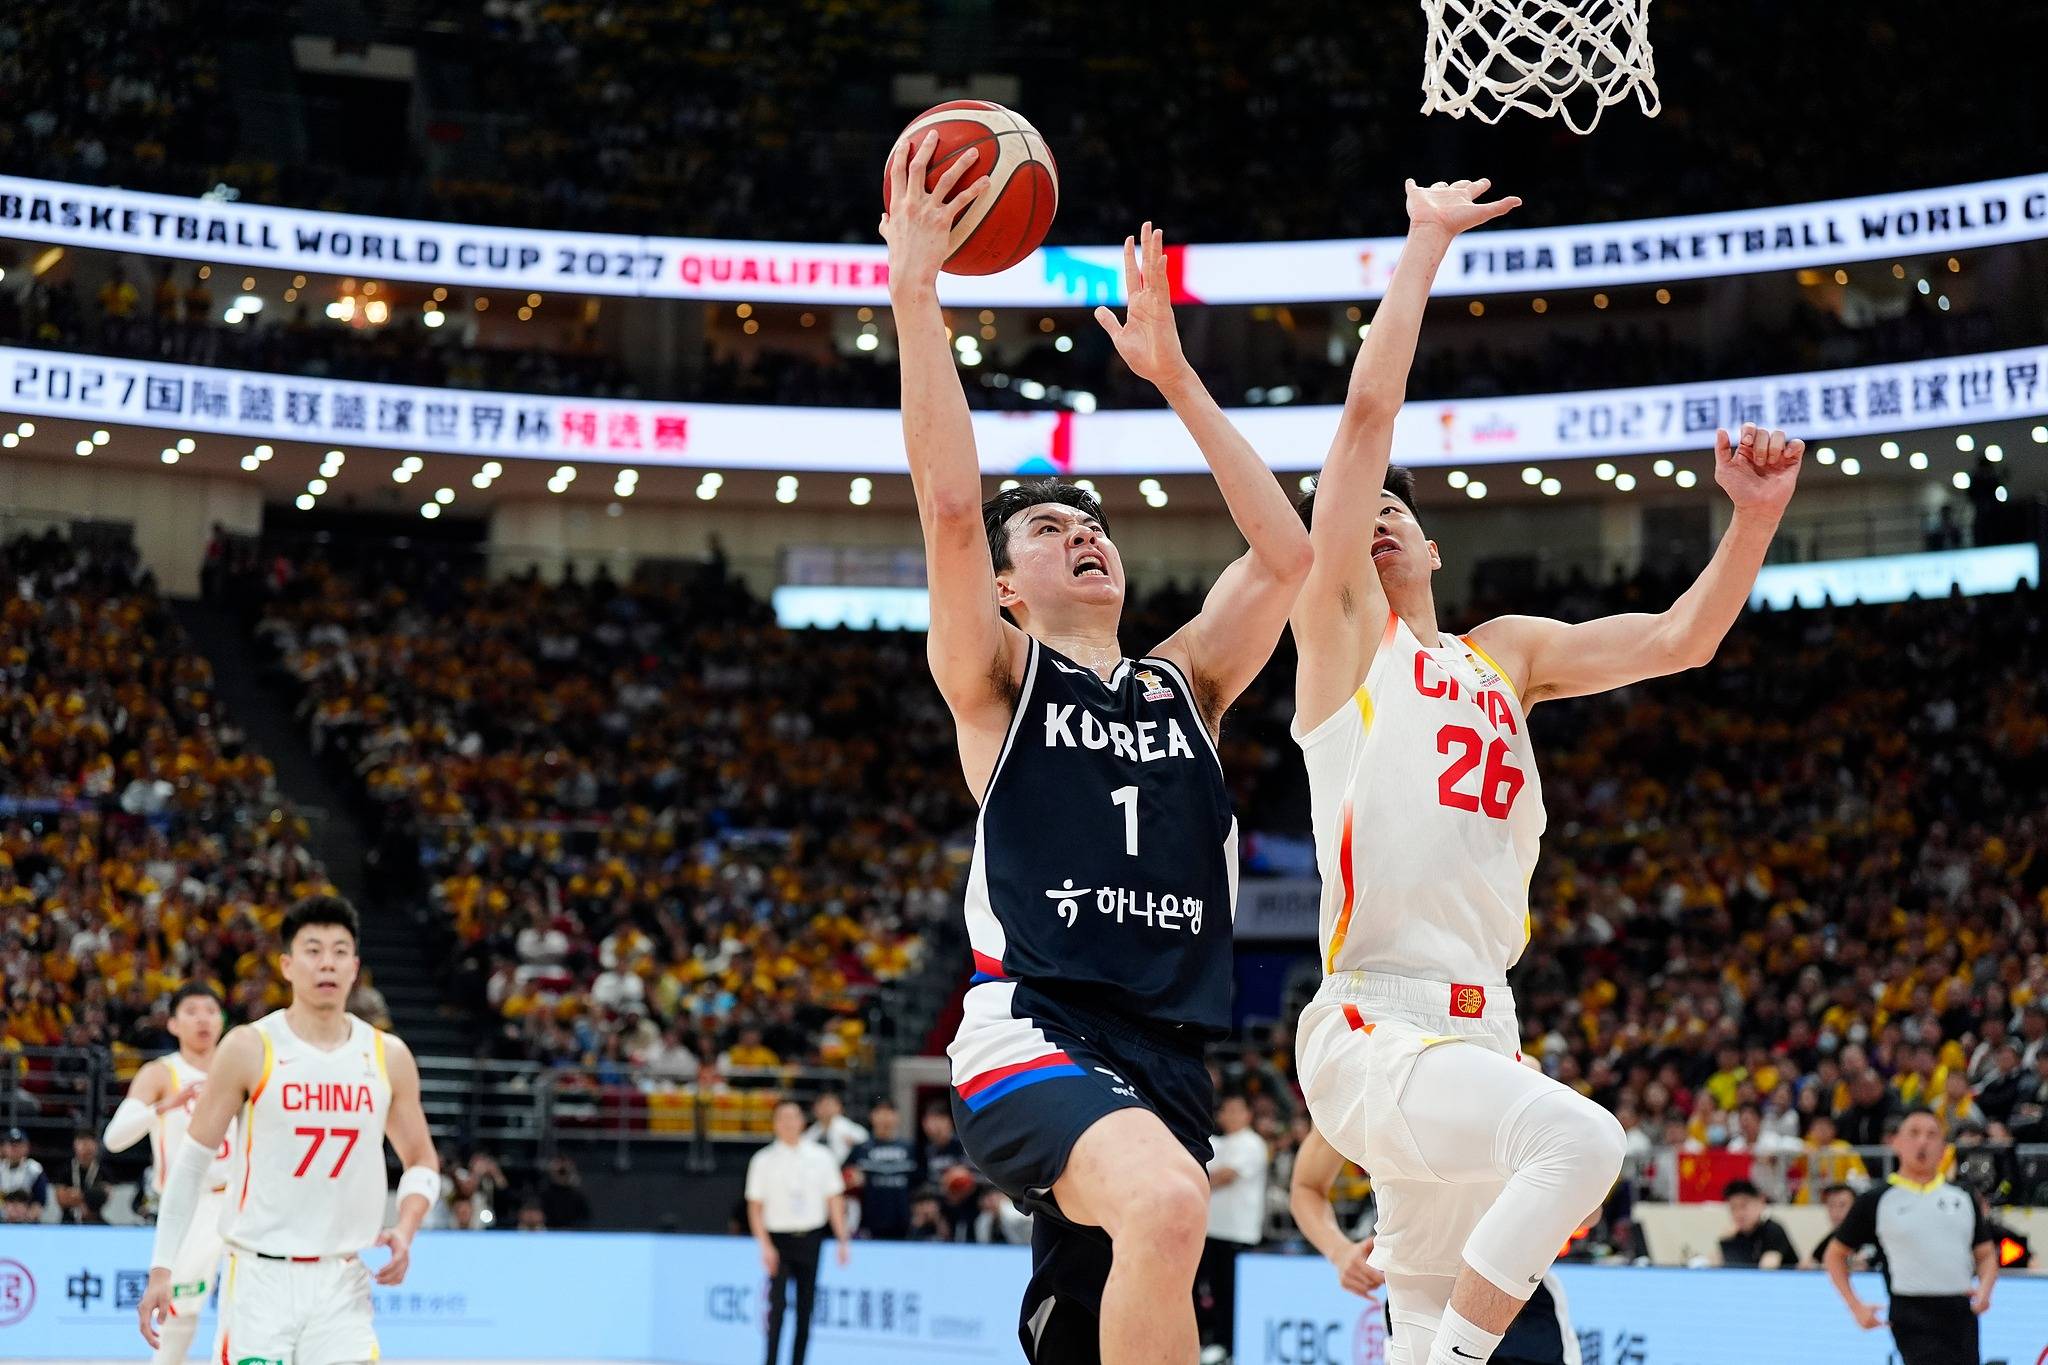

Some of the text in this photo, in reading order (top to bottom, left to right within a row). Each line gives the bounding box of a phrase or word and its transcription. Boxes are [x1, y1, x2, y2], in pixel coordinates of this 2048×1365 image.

[0, 194, 279, 249] BASKETBALL
[295, 227, 440, 264] WORLD
[456, 243, 541, 272] CUP
[556, 250, 665, 280] 2027
[1463, 247, 1554, 275] FIBA
[1573, 219, 1844, 269] BASKETBALL
[1862, 200, 2007, 240] WORLD
[1044, 702, 1195, 763] KOREA
[1436, 723, 1525, 820] 26
[1111, 785, 1139, 857] 1
[1096, 886, 1204, 935] 하나은행
[282, 1083, 374, 1114] CHINA
[294, 1127, 360, 1179] 77
